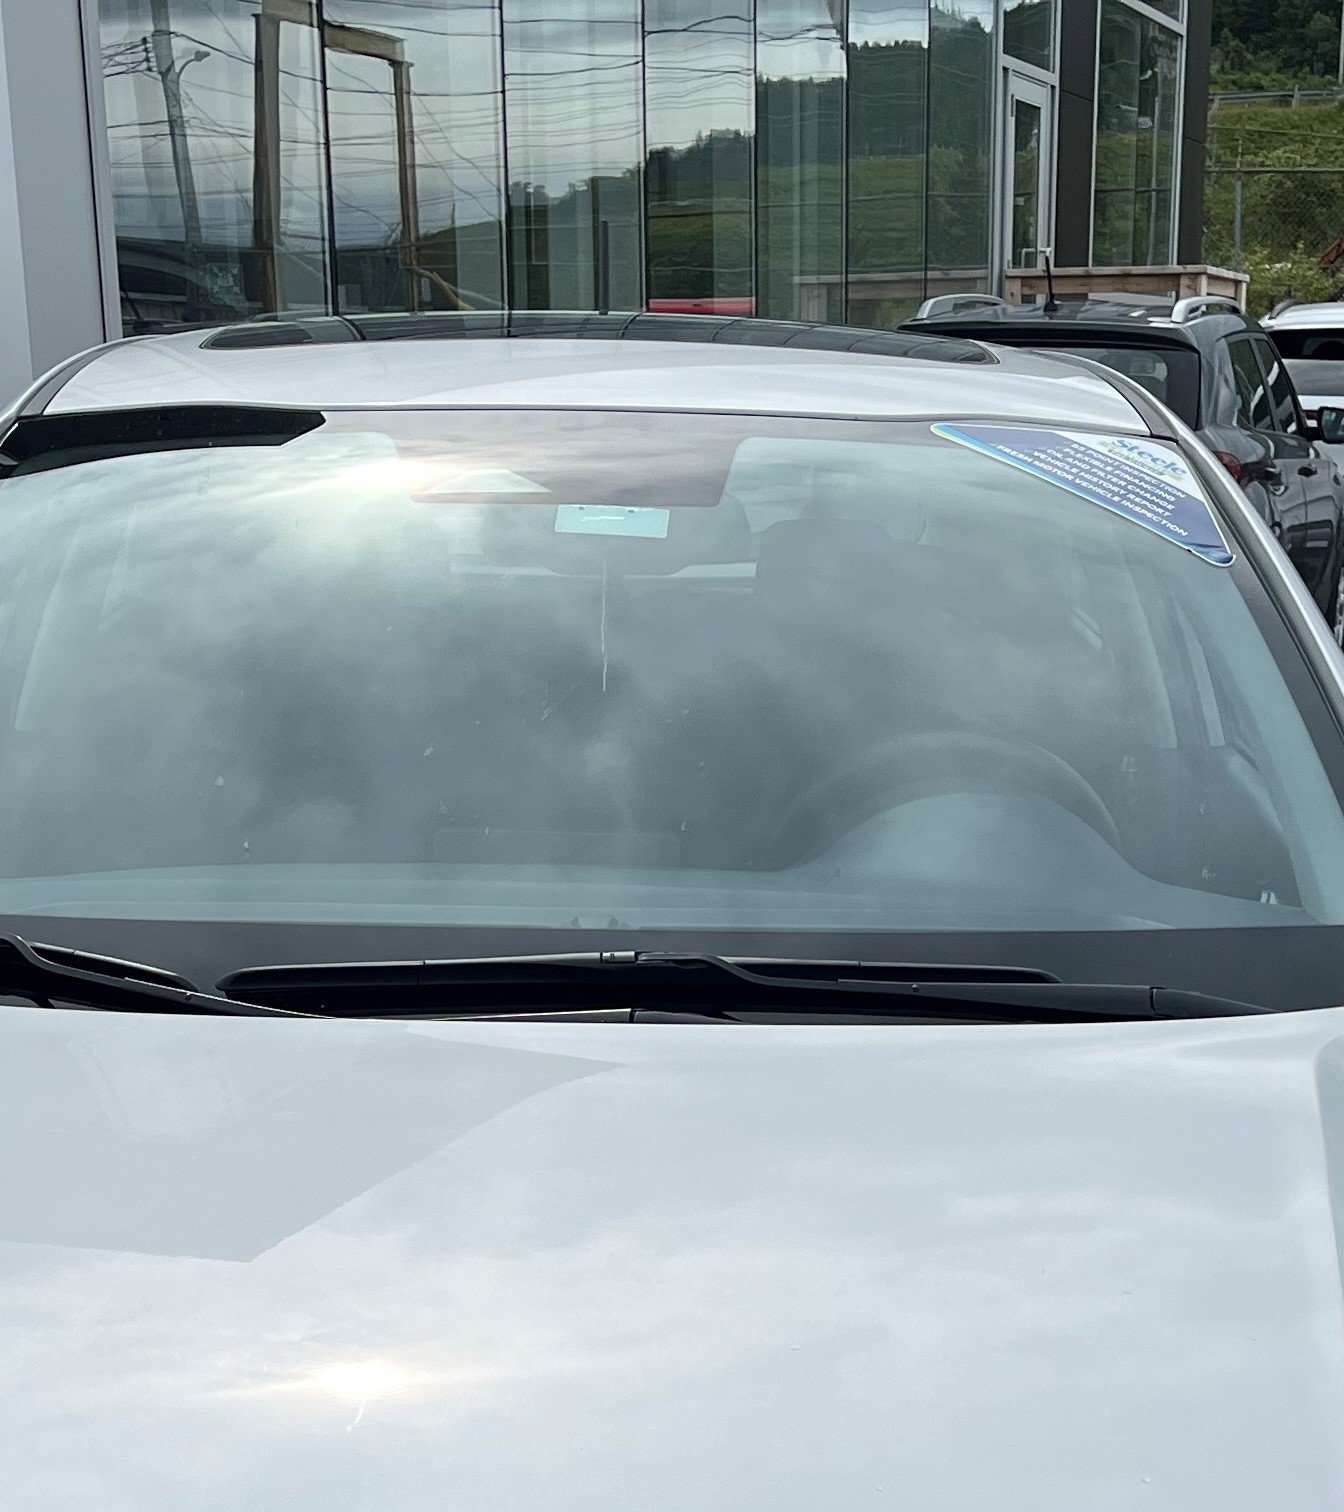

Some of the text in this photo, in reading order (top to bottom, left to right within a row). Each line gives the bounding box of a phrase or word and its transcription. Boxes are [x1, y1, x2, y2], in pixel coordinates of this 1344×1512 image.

[1115, 438, 1187, 474] Steele
[1032, 460, 1074, 480] MOTOR
[1074, 477, 1122, 502] VEHICLE
[1120, 499, 1189, 536] INSPECTION
[1064, 457, 1091, 470] AND
[1090, 468, 1127, 486] FILTER
[1127, 484, 1175, 510] CHANGE
[1078, 471, 1127, 495] HISTORY
[1125, 493, 1172, 517] REPORT
[1113, 470, 1175, 501] FINANCING
[1119, 464, 1186, 498] INSPECTION
